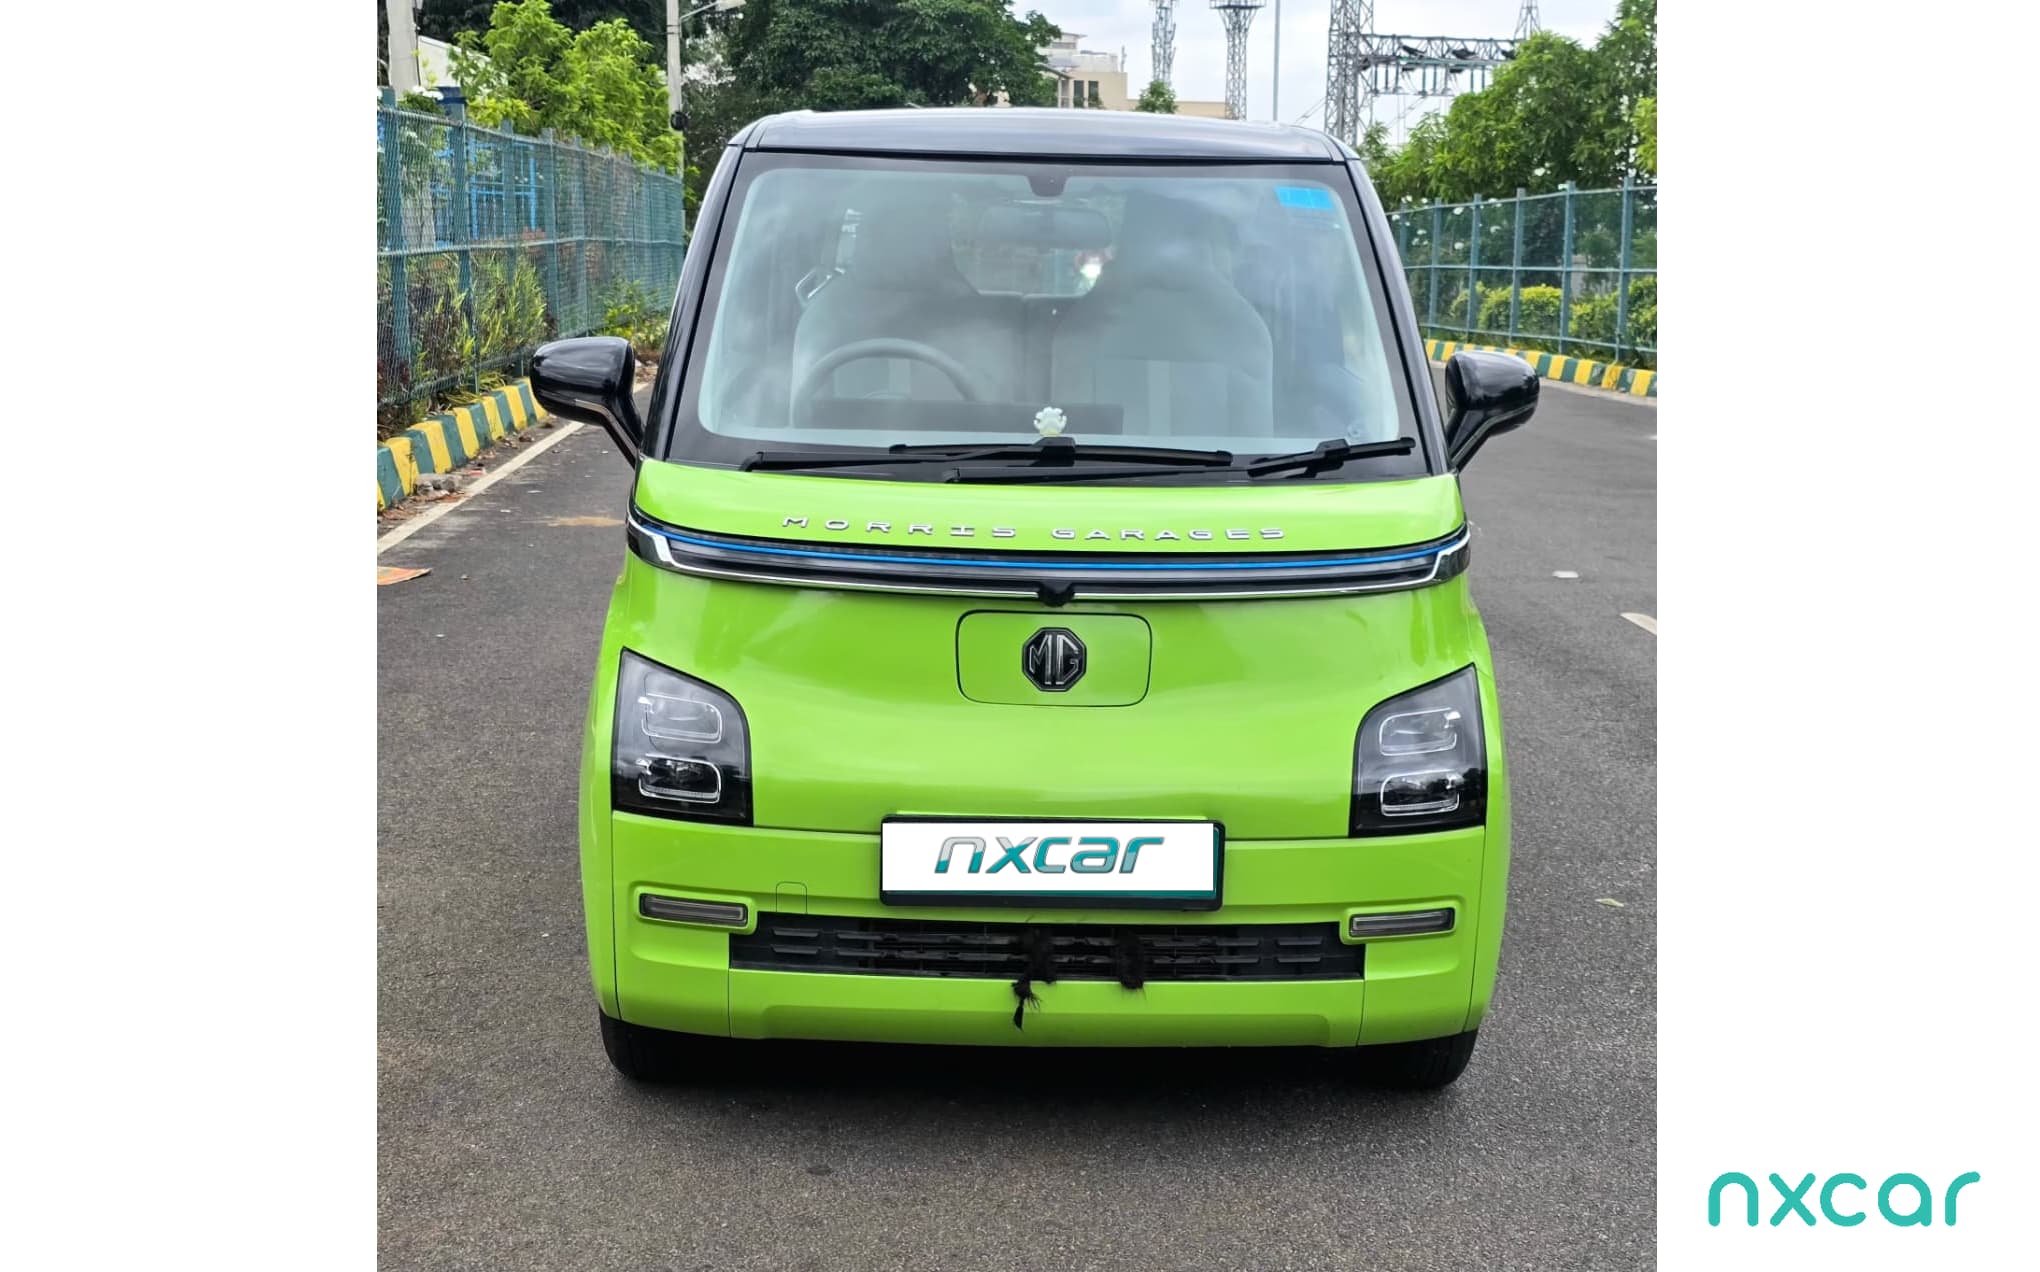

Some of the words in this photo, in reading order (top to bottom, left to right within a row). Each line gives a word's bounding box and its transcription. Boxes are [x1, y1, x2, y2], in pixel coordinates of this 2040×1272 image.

[782, 516, 1016, 538] MORRIS
[1051, 527, 1285, 541] GARAGES
[1027, 632, 1081, 687] MG
